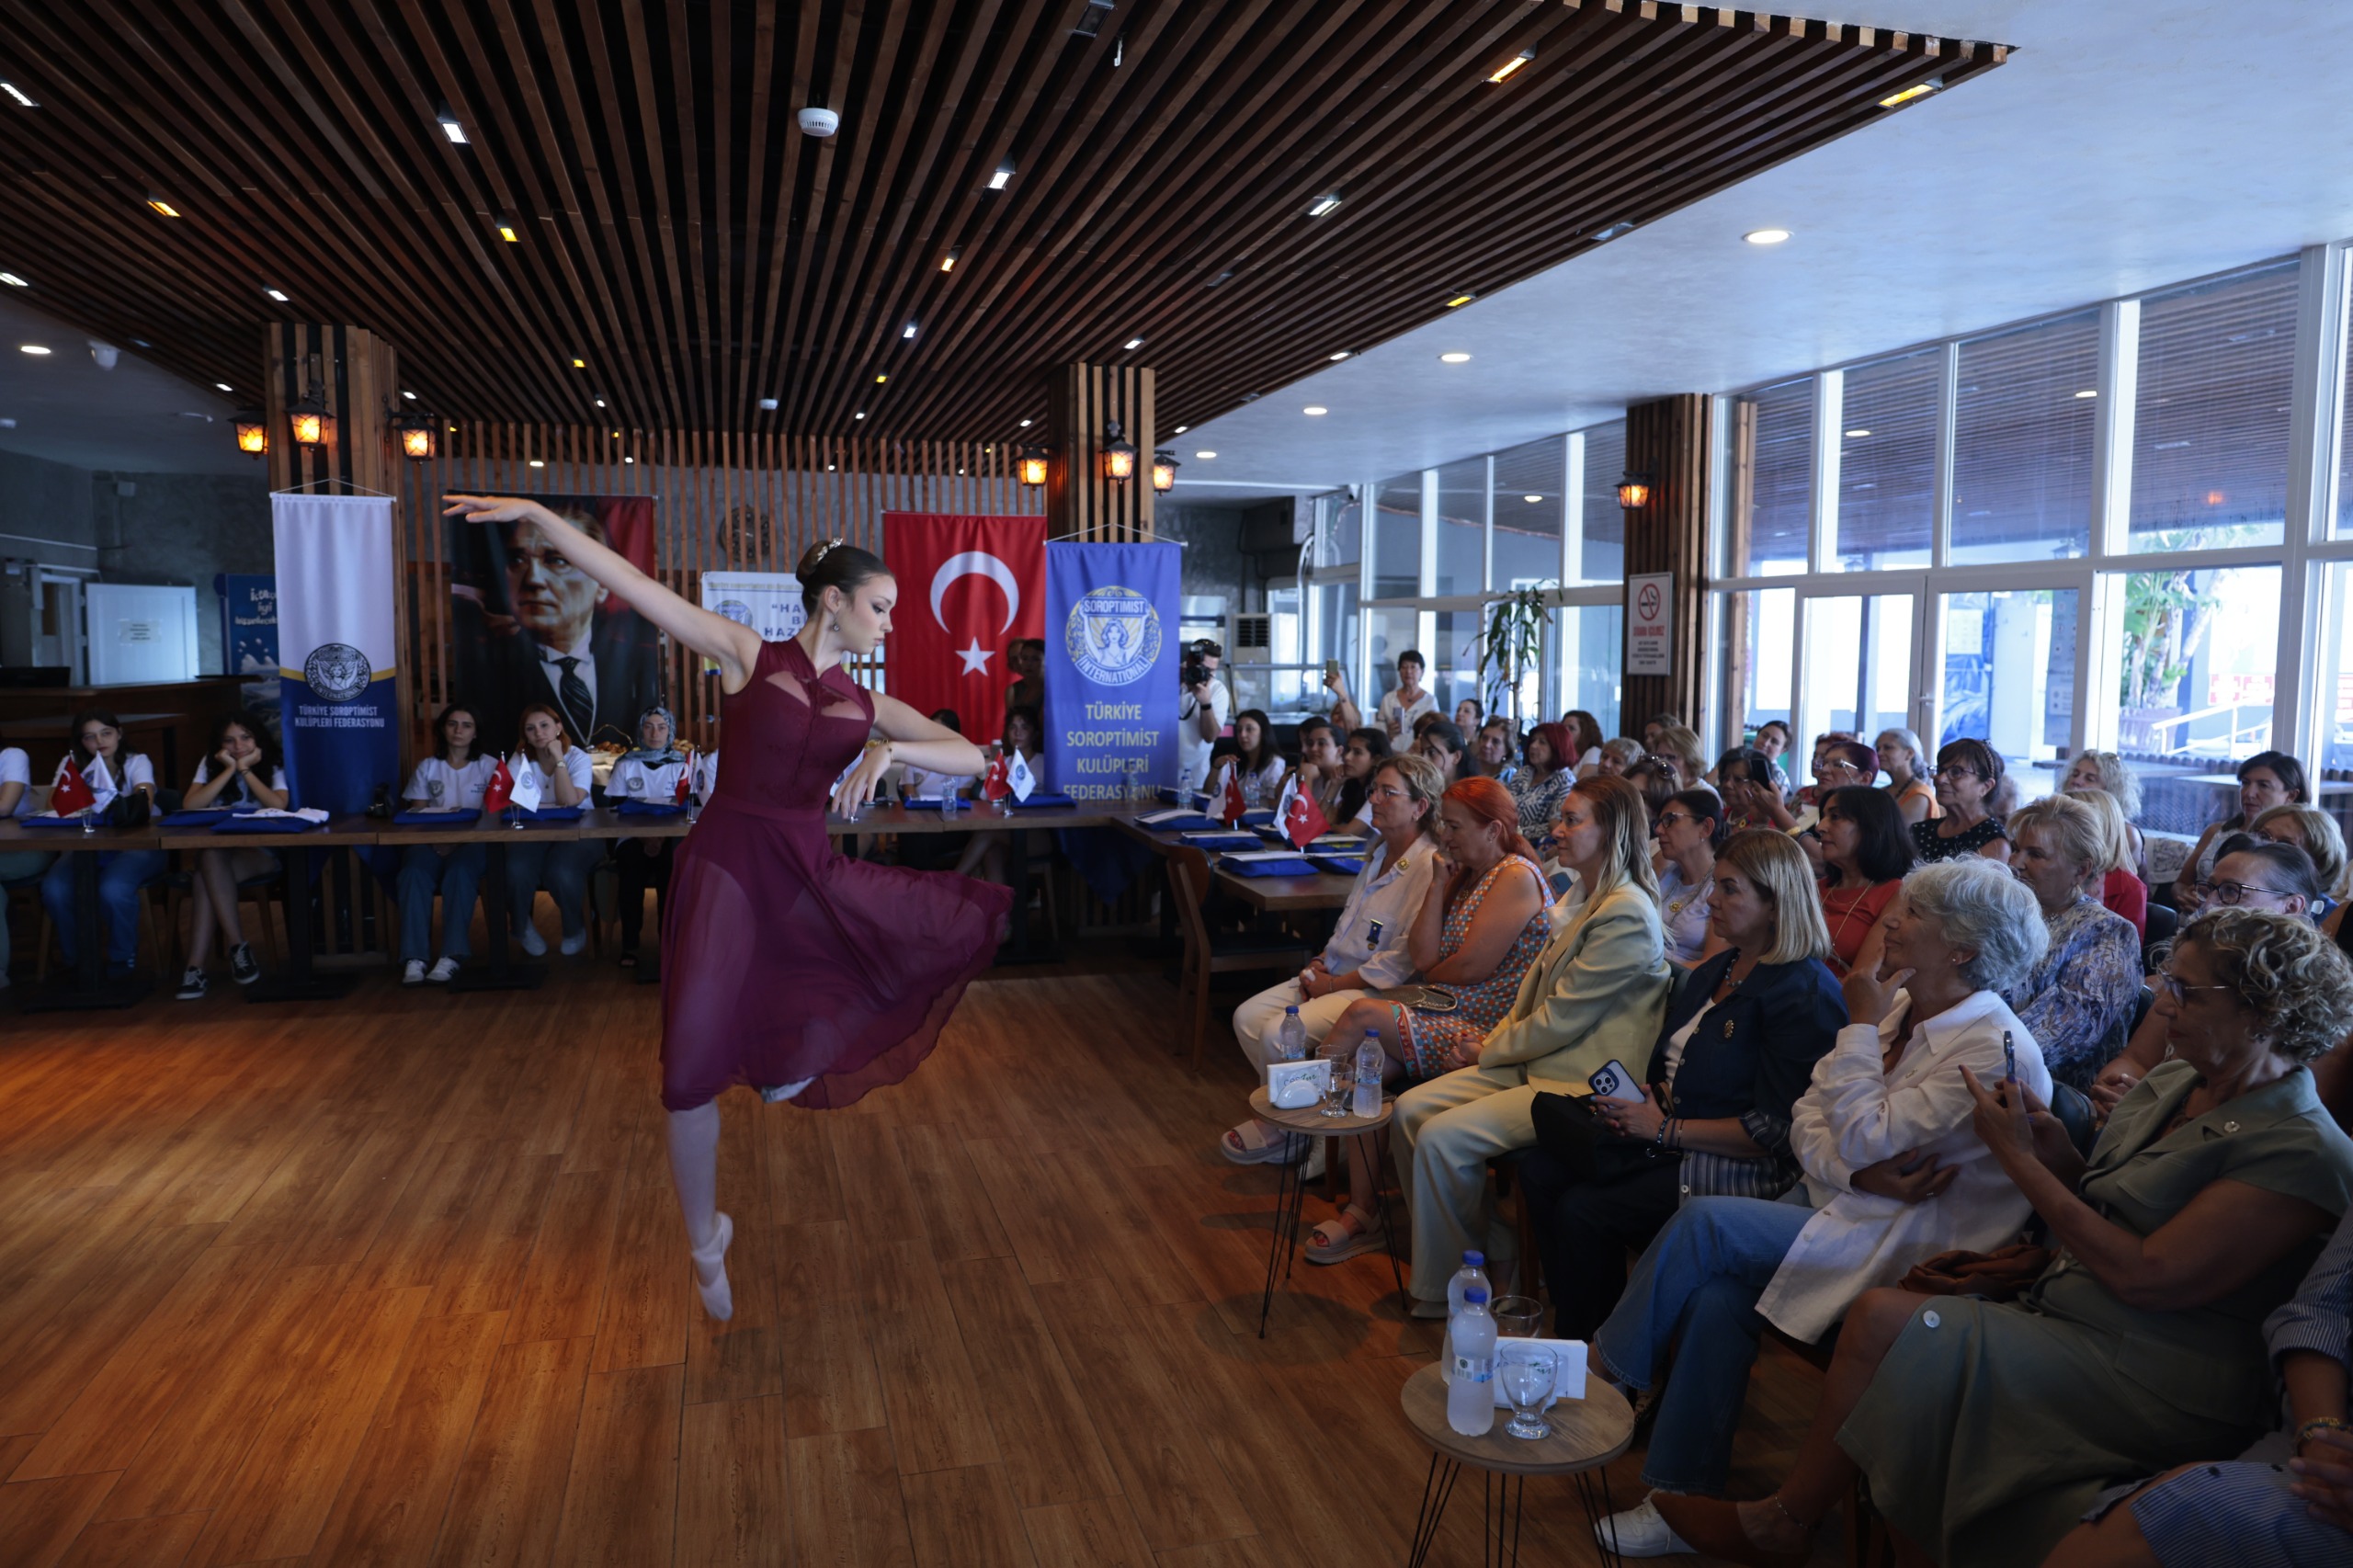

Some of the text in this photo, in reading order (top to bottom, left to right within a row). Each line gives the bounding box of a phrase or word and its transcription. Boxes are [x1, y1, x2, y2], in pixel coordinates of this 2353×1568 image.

[1085, 599, 1145, 613] SOROPTIMIST
[1078, 656, 1149, 684] INTERNATIONAL
[298, 703, 378, 717] TÜRKİYE SOROPTİMİST
[1086, 700, 1142, 721] TÜRKİYE
[294, 714, 385, 728] KULÜPLERİ FEDERASYONU
[1066, 727, 1160, 747] SOROPTİMİST
[1076, 754, 1149, 774] KULÜPLERİ
